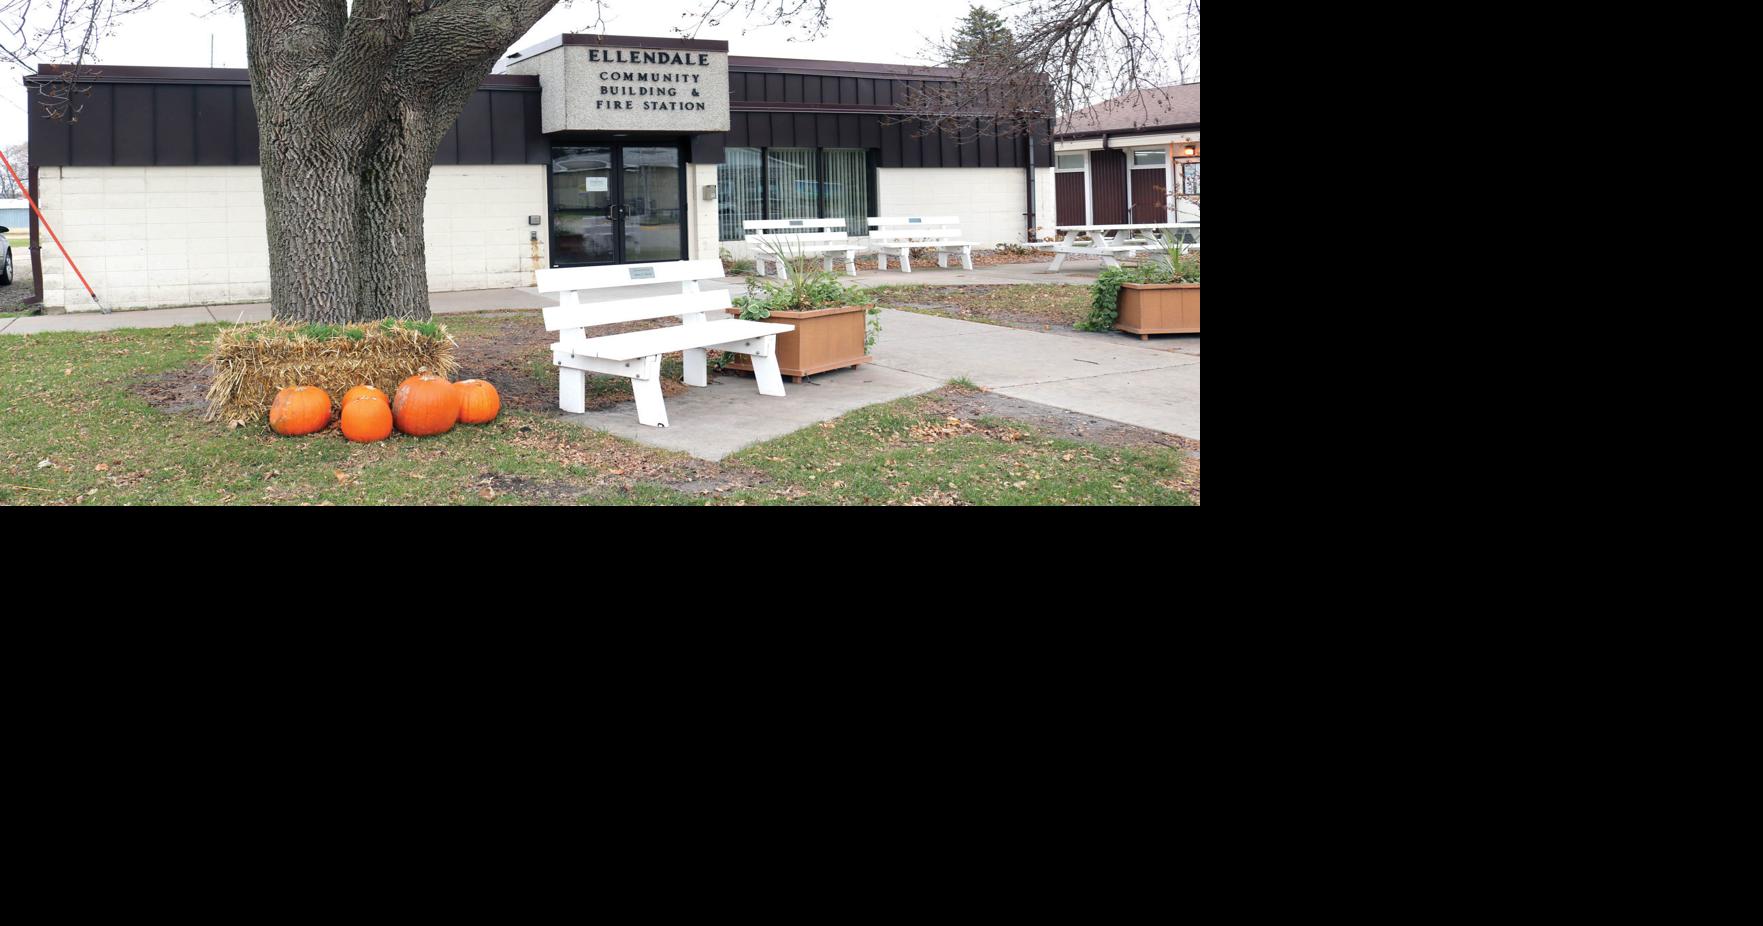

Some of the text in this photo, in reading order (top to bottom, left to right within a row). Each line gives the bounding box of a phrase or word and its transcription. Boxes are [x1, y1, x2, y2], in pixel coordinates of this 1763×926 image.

[589, 49, 709, 66] ELLENDALE
[600, 72, 700, 83] COMMUNITY
[600, 86, 700, 97] BUILDING &
[596, 101, 705, 111] FIRE STATION
